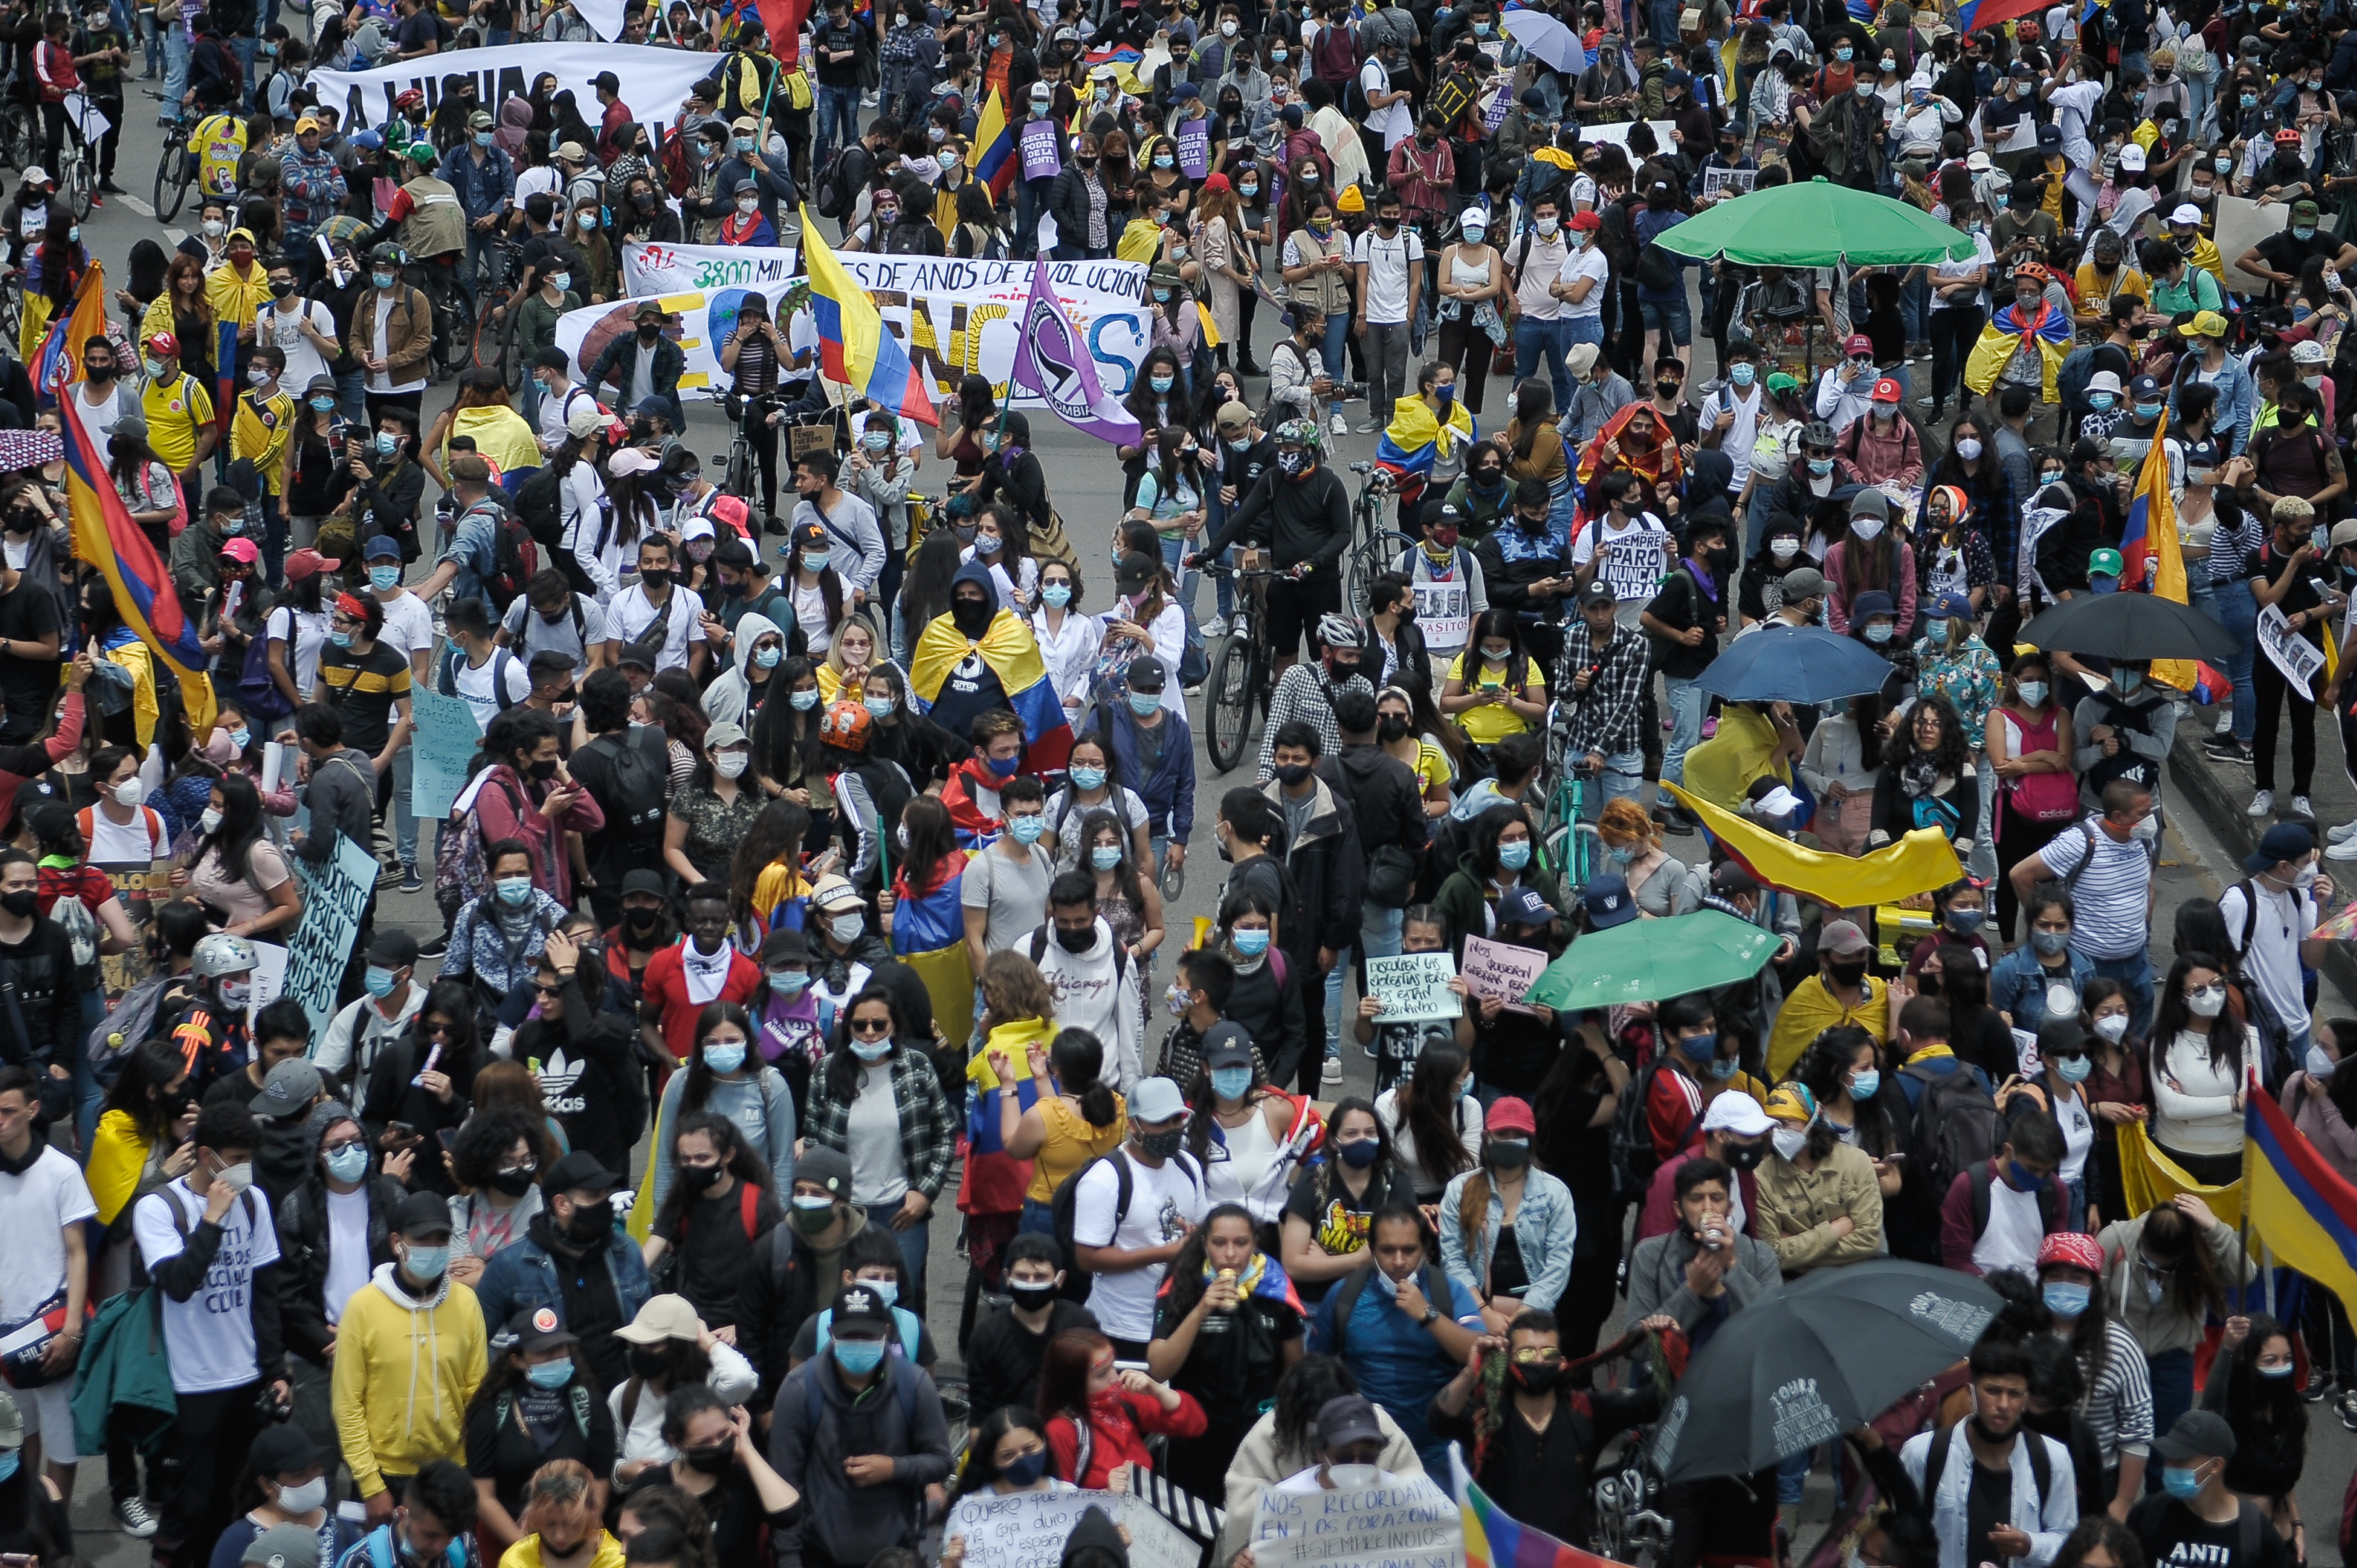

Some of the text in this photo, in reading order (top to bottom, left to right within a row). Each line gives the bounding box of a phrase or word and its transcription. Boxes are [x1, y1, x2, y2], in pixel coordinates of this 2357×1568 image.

[1023, 140, 1054, 152] PODER
[1027, 149, 1041, 158] DE
[1190, 148, 1200, 157] LA
[1025, 156, 1055, 167] GENTE
[1179, 156, 1201, 167] ENTE
[693, 260, 751, 288] 3800
[876, 264, 908, 290] DE
[983, 263, 1022, 285] DE
[794, 436, 823, 444] FUERZAS
[1612, 535, 1661, 548] SIEMPRE
[1610, 547, 1660, 566] PARO
[1608, 565, 1657, 584] NUNCA
[2038, 809, 2073, 818] adidas
[1469, 941, 1491, 958] NOS
[1424, 956, 1441, 971] LAS
[1424, 971, 1450, 984] PERO
[1371, 987, 1392, 1003] NOS
[1769, 1378, 1818, 1408] TOURS
[1262, 1492, 1302, 1515] NOS
[1260, 1519, 1288, 1540] EN
[1346, 1504, 1458, 1531] CORAZONES
[2169, 1542, 2231, 1564] ANTI
